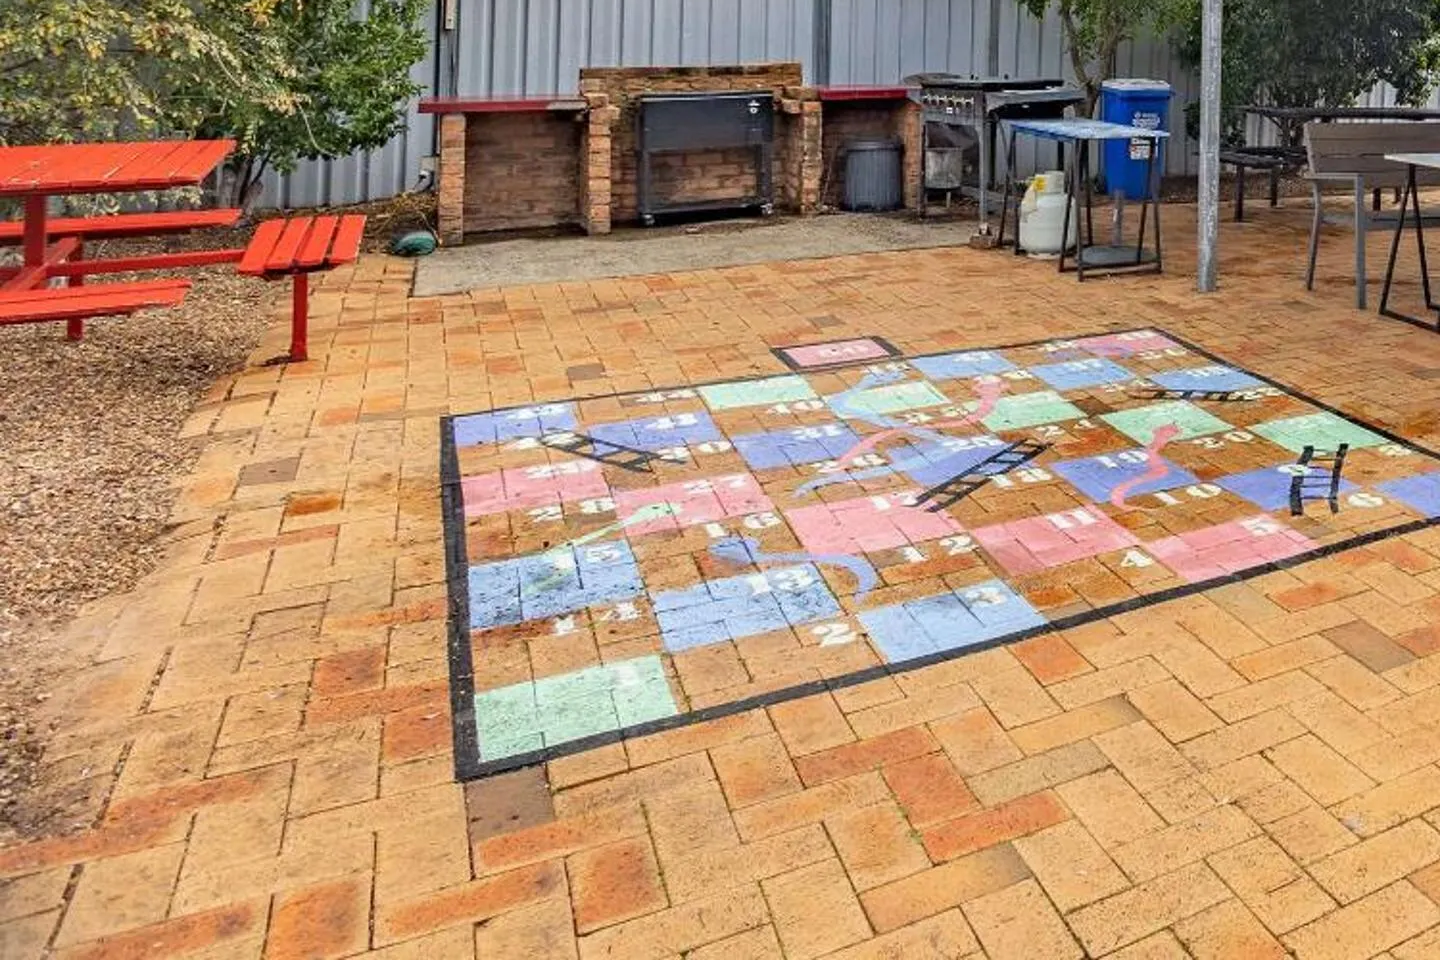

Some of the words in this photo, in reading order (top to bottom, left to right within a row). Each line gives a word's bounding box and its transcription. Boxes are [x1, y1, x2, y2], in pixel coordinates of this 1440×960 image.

[1153, 483, 1222, 505] 10
[1047, 508, 1097, 529] 11
[1121, 550, 1153, 568] 4
[811, 622, 857, 647] 2
